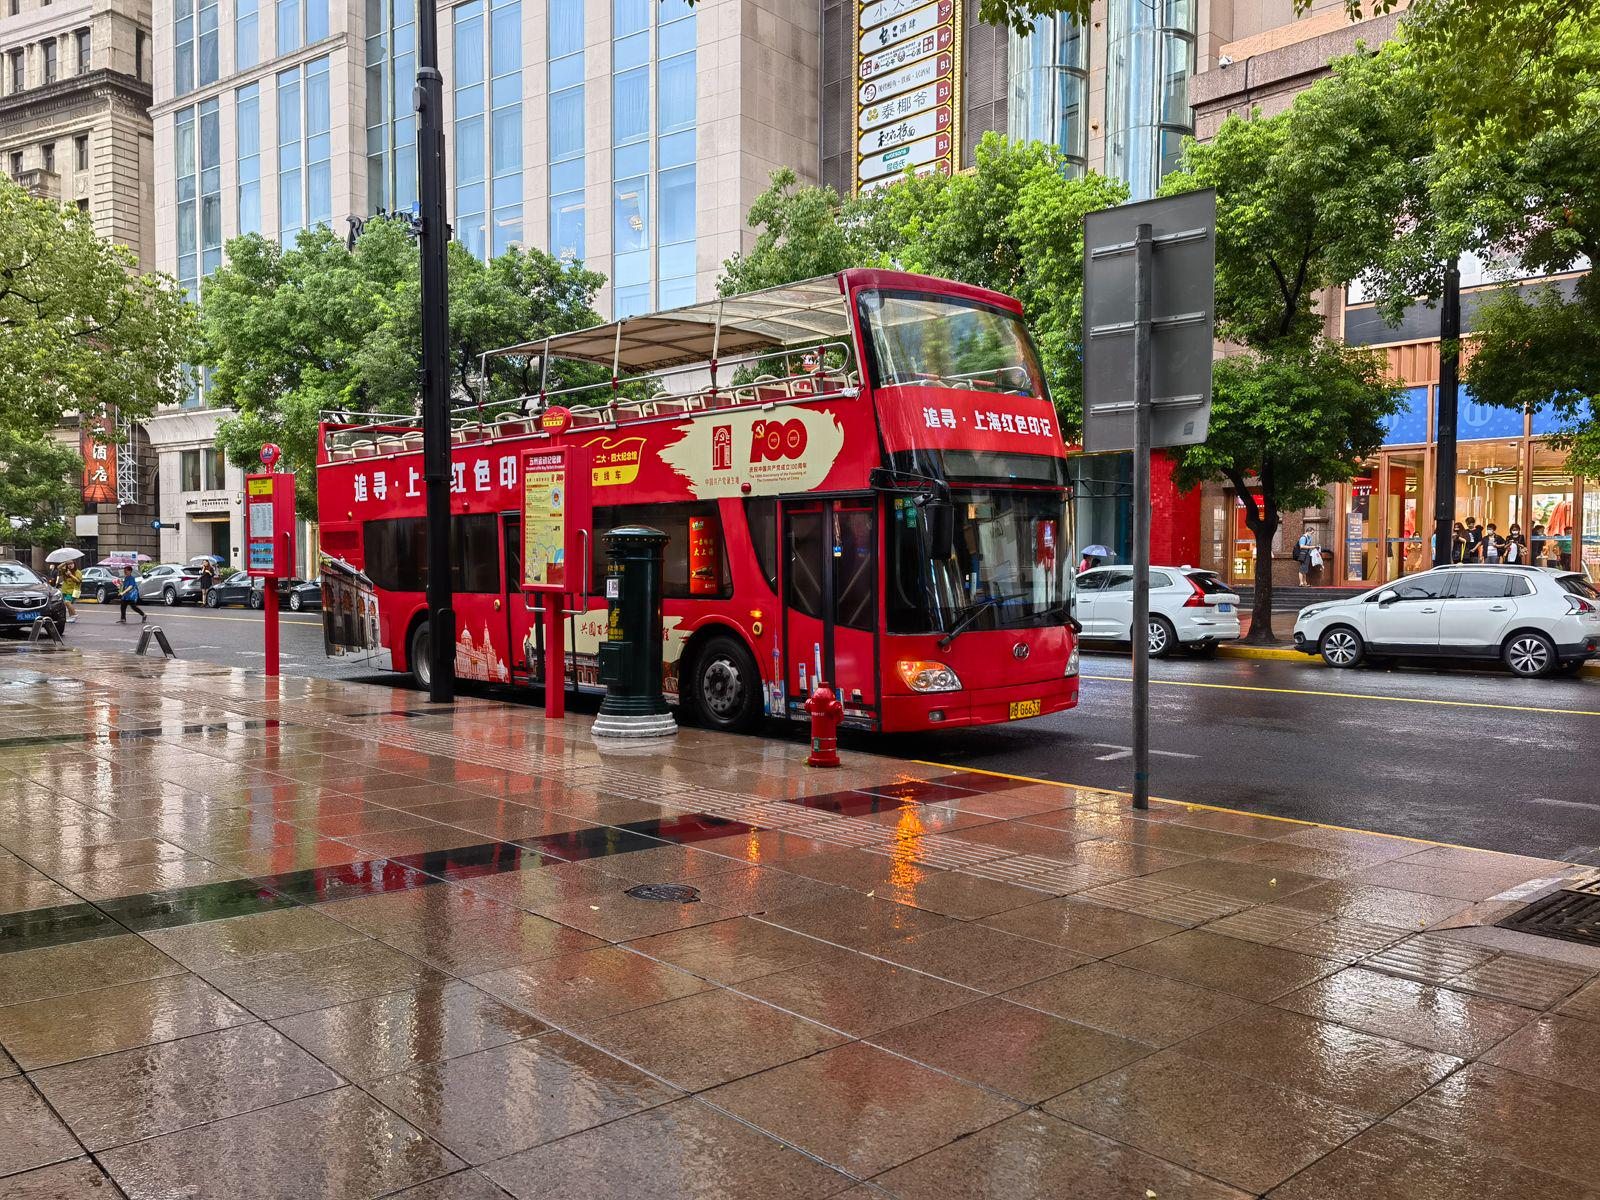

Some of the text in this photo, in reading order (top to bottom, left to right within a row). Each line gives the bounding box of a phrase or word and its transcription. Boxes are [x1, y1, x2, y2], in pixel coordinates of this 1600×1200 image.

[940, 32, 950, 43] 4F
[940, 59, 950, 70] B1
[940, 86, 949, 97] B1
[881, 91, 928, 120] 泰椰爷
[939, 113, 949, 124] B1
[938, 139, 949, 150] B1
[922, 406, 1053, 437] 追寻·上海红色印记
[750, 418, 808, 463] 100
